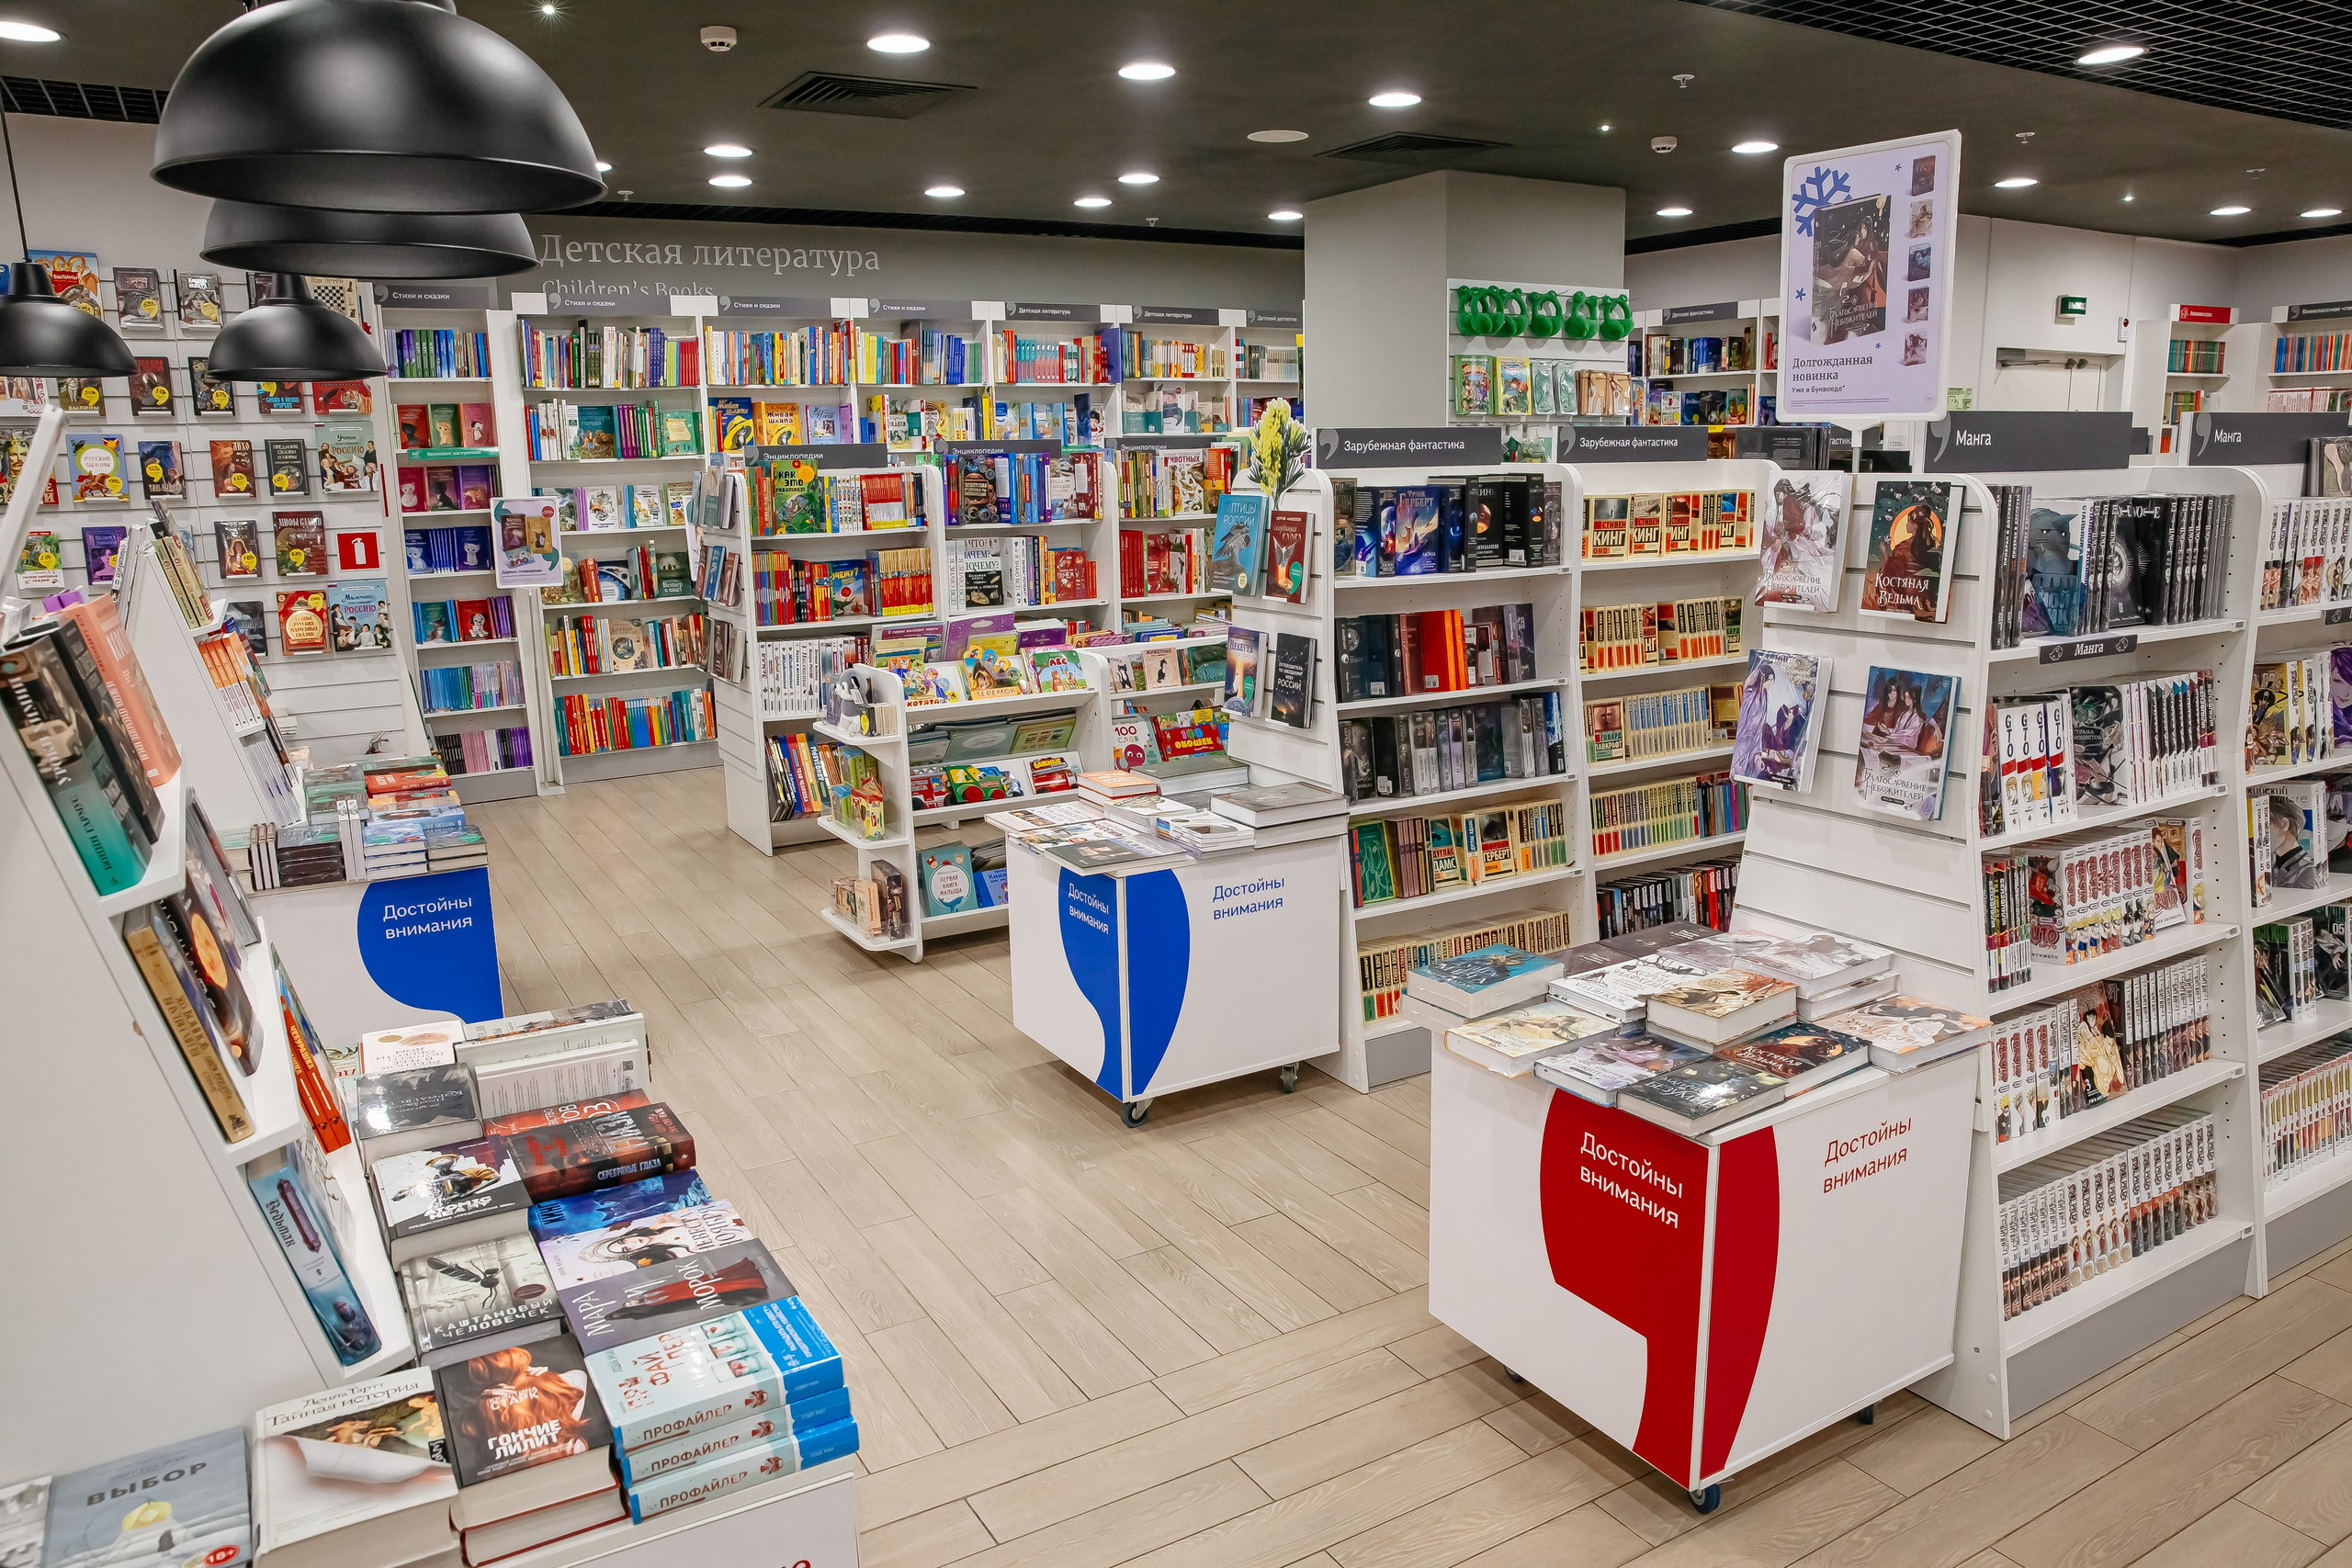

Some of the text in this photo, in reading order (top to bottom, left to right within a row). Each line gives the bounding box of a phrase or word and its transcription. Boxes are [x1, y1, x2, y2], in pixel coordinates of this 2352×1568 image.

[540, 234, 880, 276] Детская литература
[654, 281, 714, 296] Books
[1019, 307, 1041, 315] Детская
[1792, 355, 1873, 368] Долгожданная
[1792, 371, 1838, 382] новинка
[1792, 387, 1805, 395] Уже
[1344, 439, 1464, 454] Зарубежная фантастика
[1579, 436, 1678, 449] Зарубежная фантастика
[1956, 430, 1991, 446] Манга
[2214, 429, 2242, 443] Манга
[332, 446, 365, 455] РОССИЮ
[1230, 502, 1256, 514] ПТИЦЫ
[1223, 514, 1255, 526] РОССИИ
[968, 539, 988, 548] ЧТО?
[1594, 530, 1625, 546] КИНГ
[1764, 569, 1822, 585] БЛАГОСЛОВЕНИЕ
[1875, 573, 1929, 590] КОСТЯНАЯ
[345, 605, 376, 614] РОССИЮ
[1878, 590, 1921, 609] ВЕДЬМА
[2075, 643, 2104, 656] Манга
[907, 698, 940, 707] КОТЯТА
[977, 688, 1015, 697] ТЕРЕМОК
[1114, 726, 1136, 736] 100
[1181, 728, 1203, 739] 100
[2005, 714, 2013, 759] GTO
[2021, 713, 2030, 757] GTO
[2036, 710, 2044, 753] GTO
[2053, 708, 2062, 750] GTO
[1175, 738, 1213, 749] ОКОШЕК
[1863, 768, 1927, 792] БЛАГОСЛОВЕНИЕ
[1865, 781, 1924, 801] НЕБОЖИТЕЛЕЙ
[1434, 858, 1457, 872] ДАМС
[1483, 849, 1510, 862] ГЕРБЕРТ
[1069, 883, 1109, 915] Достойны
[1213, 877, 1284, 903] Достойны
[382, 897, 472, 922] Достойны
[1214, 897, 1283, 919] внимания
[385, 917, 472, 939] внимания
[1069, 905, 1109, 934] внимания
[289, 1025, 314, 1070] ЧЕБУРАШКА
[1824, 1117, 1912, 1167] Достойны
[597, 1158, 662, 1180] СЕРЕБРЯНЫЕ ГЛАЗА
[1580, 1131, 1682, 1198] Достойны
[1822, 1147, 1907, 1194] внимания
[1580, 1166, 1679, 1229] внимания
[265, 1198, 297, 1248] Ведьмак
[675, 1258, 725, 1312] МОРОК
[434, 1298, 553, 1334] КАШТАНОВЫЙ
[442, 1306, 550, 1338] ЧЕЛОВЕЧЕК
[571, 1290, 617, 1337] МАРА
[266, 1382, 421, 1427] Тайная история
[643, 1404, 733, 1441] ПРОФАЙЛЕР
[487, 1419, 562, 1450] ГОНЧИЕ
[495, 1432, 559, 1461] ЛИЛИТ
[650, 1435, 740, 1472] ПРОФАЙЛЕР
[86, 1462, 208, 1506] ВЫБОР
[660, 1471, 748, 1509] ПРОФАЙЛЕР
[208, 1547, 236, 1564] 18+
